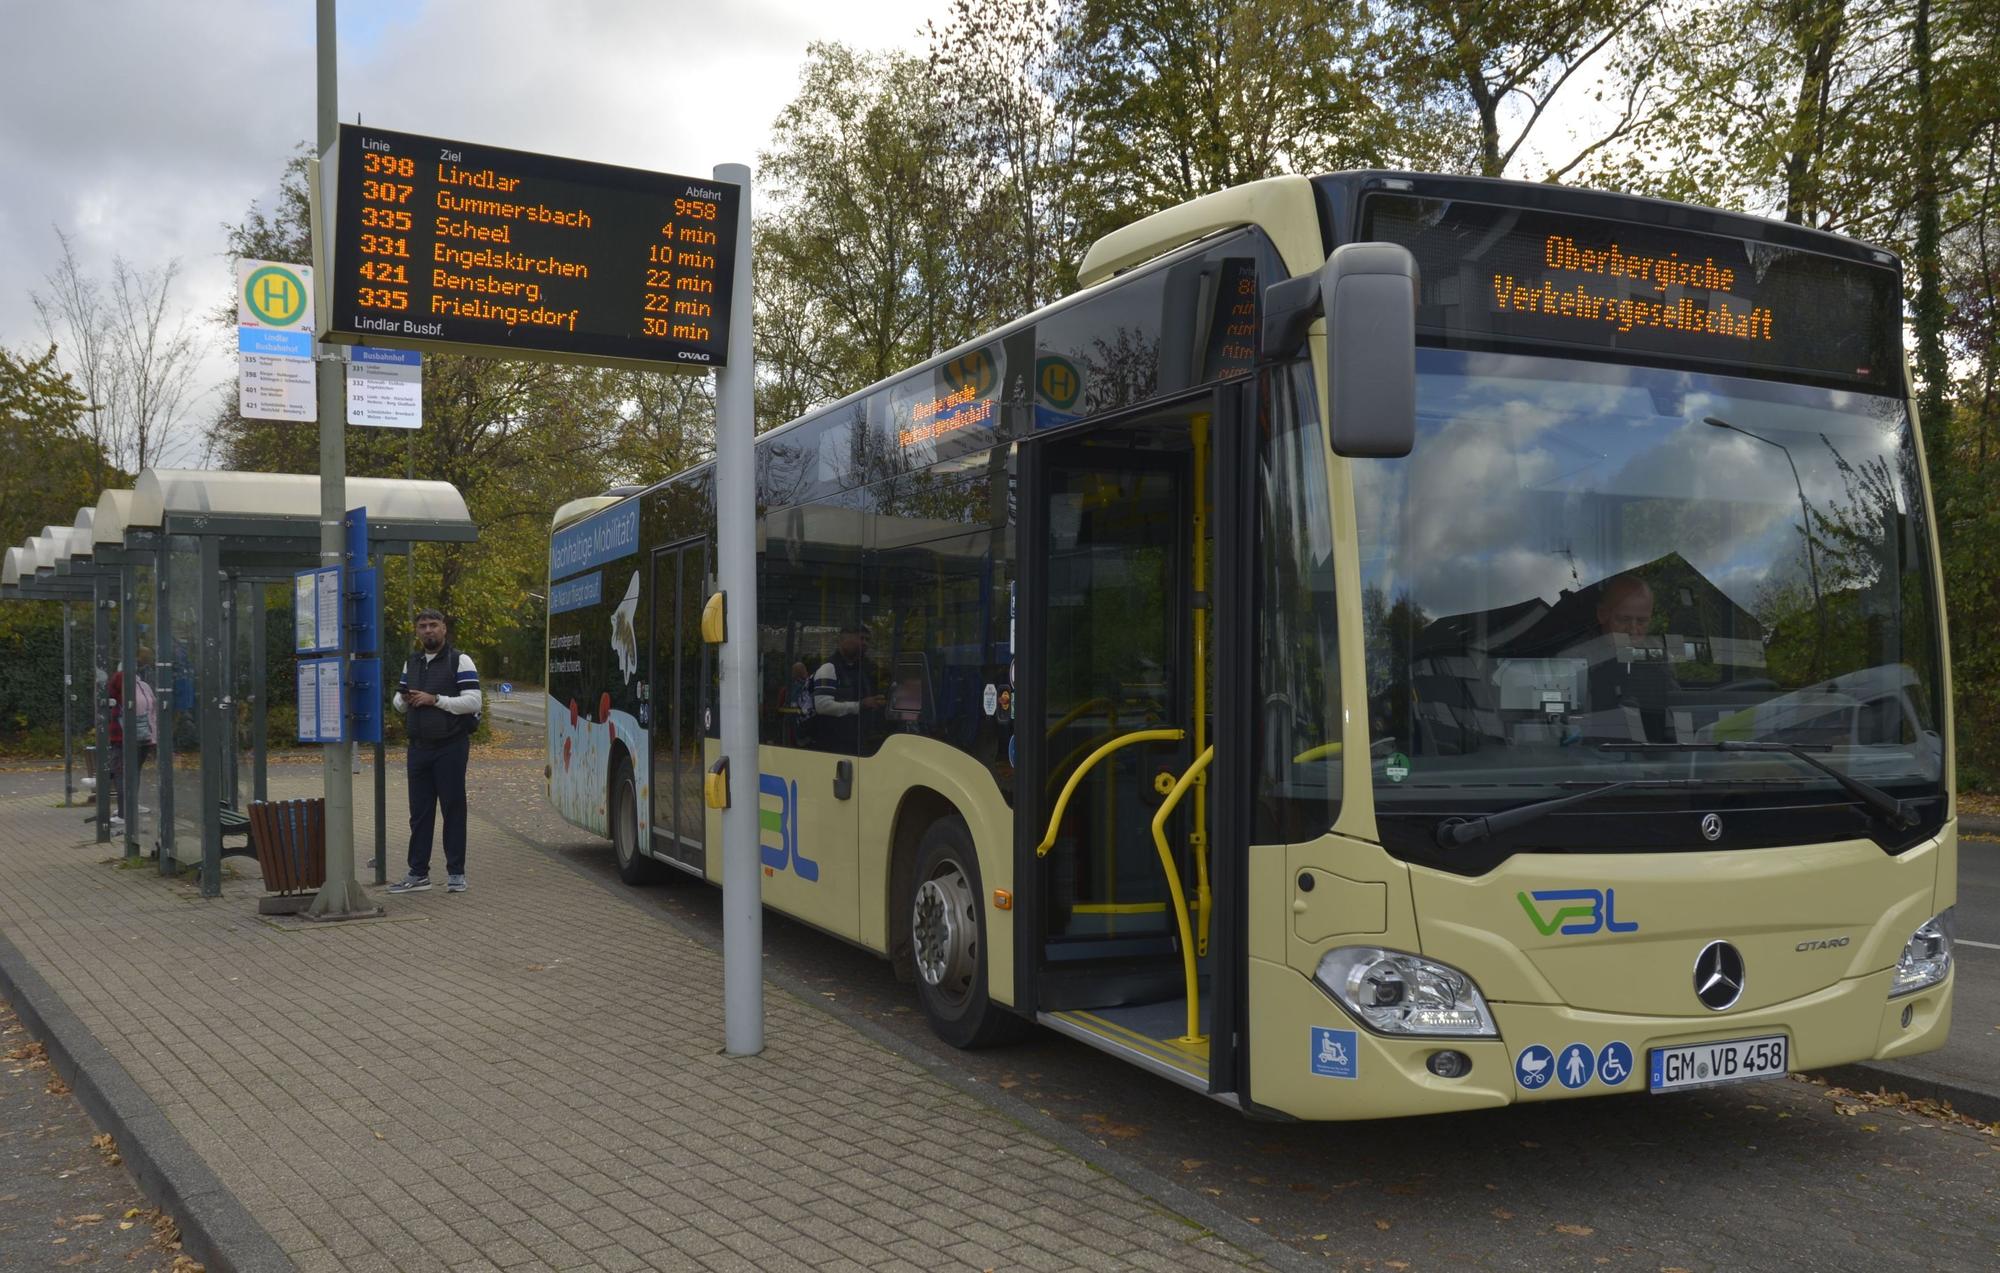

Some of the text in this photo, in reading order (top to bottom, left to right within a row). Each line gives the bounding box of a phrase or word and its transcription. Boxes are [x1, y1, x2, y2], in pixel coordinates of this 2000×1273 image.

[361, 137, 722, 201] Linie Ziel Abfahrt
[363, 153, 717, 221] 398 Lindlar 9:58
[361, 207, 715, 269] 335 Scheel 10 min
[362, 180, 717, 245] 307 Gummersbach 4 min
[359, 261, 712, 317] 421 Bensberg 22 min
[360, 234, 713, 293] 331 Engelskirchen 22 min
[1544, 233, 1736, 293] Oberbergische
[263, 278, 289, 314] H
[358, 287, 710, 341] 335 Frielingsdorf 30 min
[1493, 273, 1775, 342] Verkehrsgesellschaft
[354, 316, 445, 336] Lindlar Busbf.
[363, 351, 405, 363] Busbahnhof
[678, 351, 711, 362] OVAG
[759, 773, 819, 883] BL
[1516, 887, 1639, 936] VBL
[1665, 1050, 1696, 1082] GM
[1710, 1047, 1738, 1077] VB
[1743, 1042, 1782, 1073] 458
